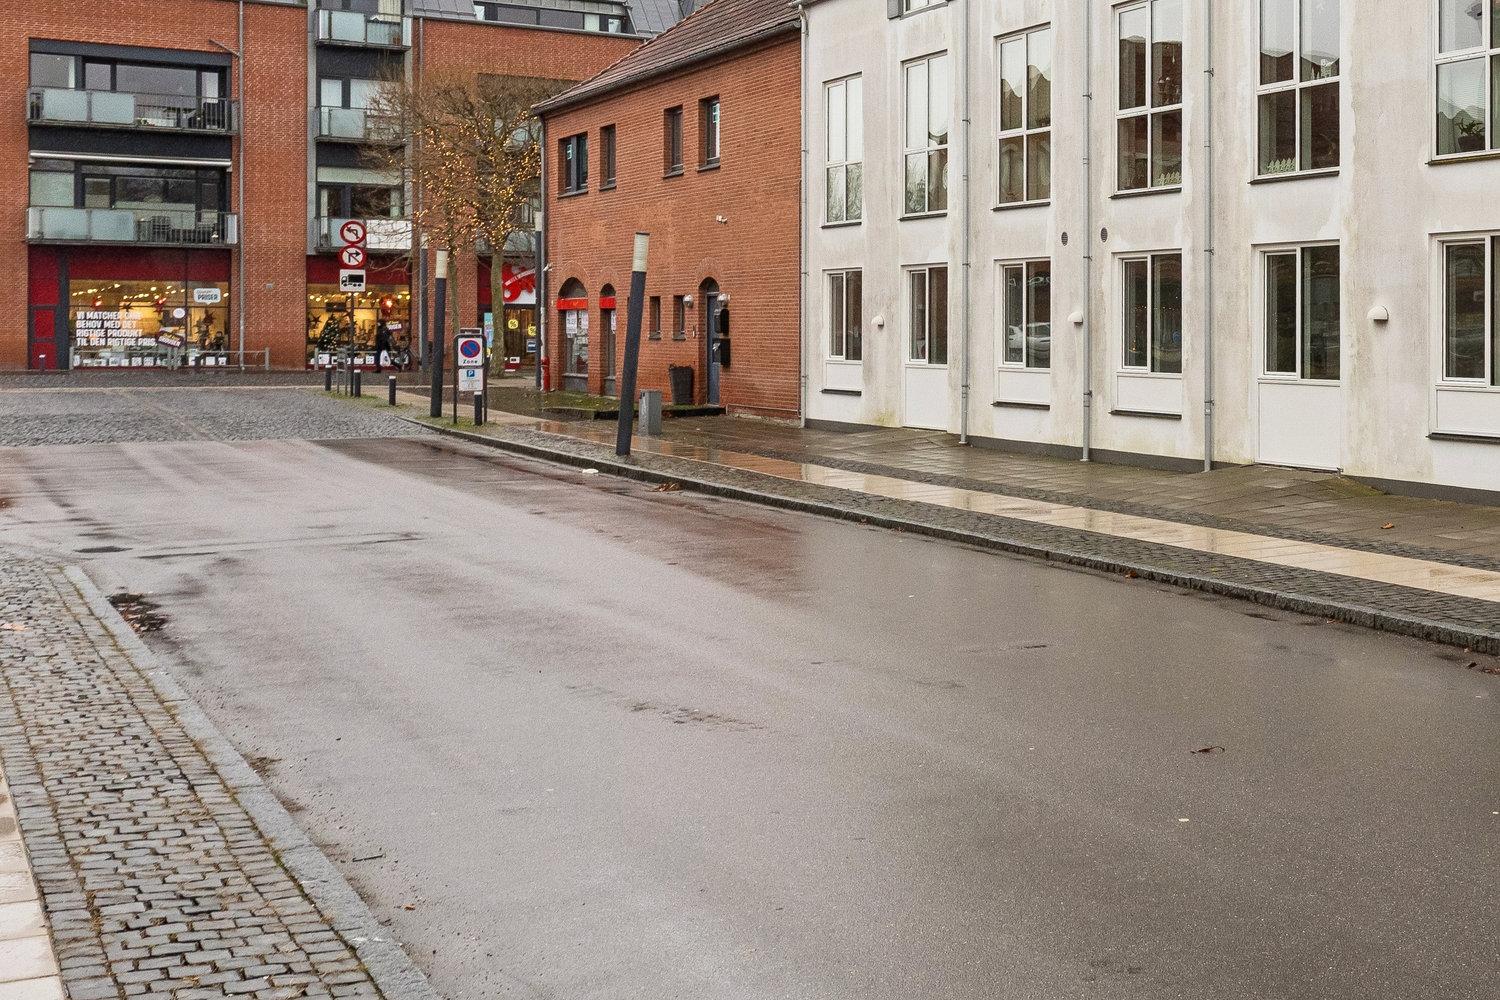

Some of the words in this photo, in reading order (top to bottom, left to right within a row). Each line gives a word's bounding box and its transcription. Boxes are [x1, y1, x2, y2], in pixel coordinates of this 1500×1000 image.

[76, 311, 85, 320] VI
[86, 311, 122, 320] MATCHER
[76, 320, 102, 329] BEHOV
[104, 320, 121, 329] MED
[76, 329, 106, 338] RIGTIGE
[107, 329, 143, 338] PRODUKT
[76, 338, 88, 347] TIL
[90, 338, 106, 347] DEN
[107, 338, 137, 347] RIGTIGE
